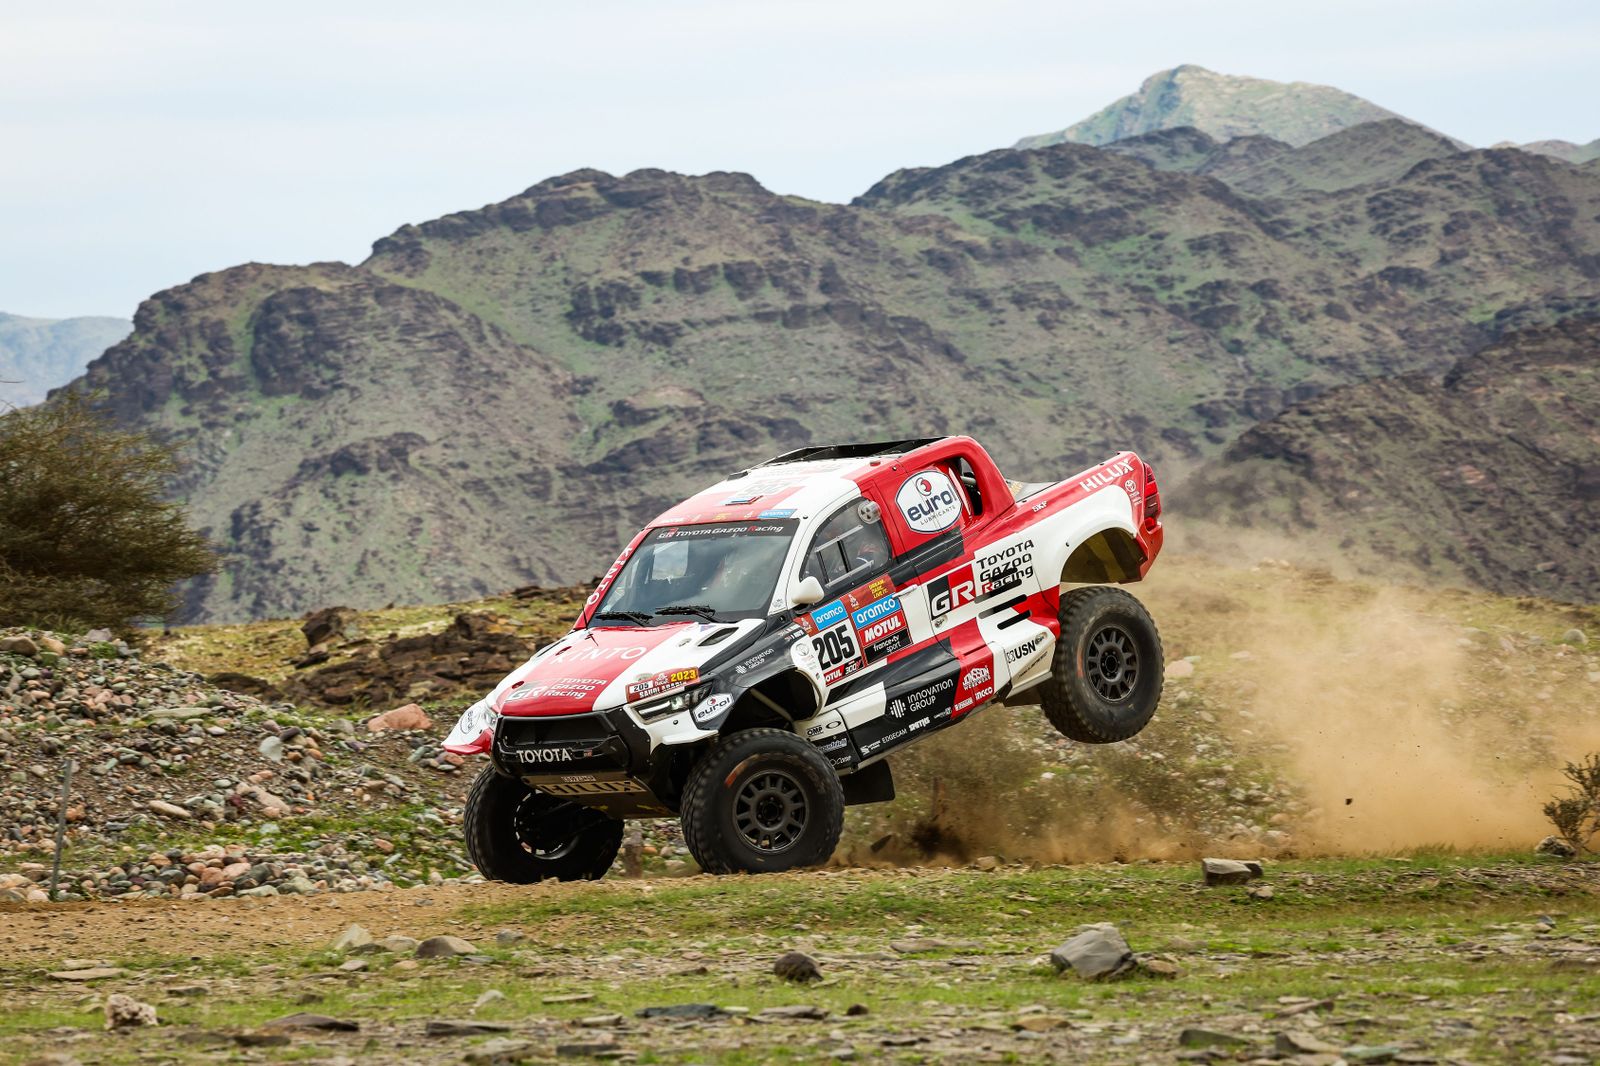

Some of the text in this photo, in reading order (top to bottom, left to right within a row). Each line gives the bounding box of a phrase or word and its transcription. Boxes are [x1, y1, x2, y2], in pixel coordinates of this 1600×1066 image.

[1079, 459, 1135, 493] HILUX
[907, 482, 958, 522] eurol
[676, 529, 712, 537] TOYOTA
[747, 525, 784, 533] Racing
[976, 539, 1035, 570] TOYOTA
[587, 547, 633, 605] KINTO
[980, 553, 1032, 582] GAZOO
[982, 566, 1034, 594] Racing
[931, 580, 975, 618] GR
[816, 605, 844, 624] aramco
[857, 598, 896, 624] aramco
[864, 615, 902, 643] MOTUL
[549, 646, 648, 664] KINTO
[811, 624, 856, 671] 205
[886, 641, 901, 653] sport
[1014, 639, 1037, 659] USN
[561, 677, 608, 685] TOYOTA
[670, 669, 697, 683] 2023
[543, 689, 587, 699] Racing
[550, 683, 596, 691] GAZOO
[633, 682, 650, 693] 205
[907, 678, 954, 704] INNOVATION
[697, 697, 731, 719] eurol
[909, 695, 937, 713] GROUP
[807, 726, 823, 736] OMP
[881, 727, 908, 744] EDGECAM
[516, 747, 573, 764] TOYOTA
